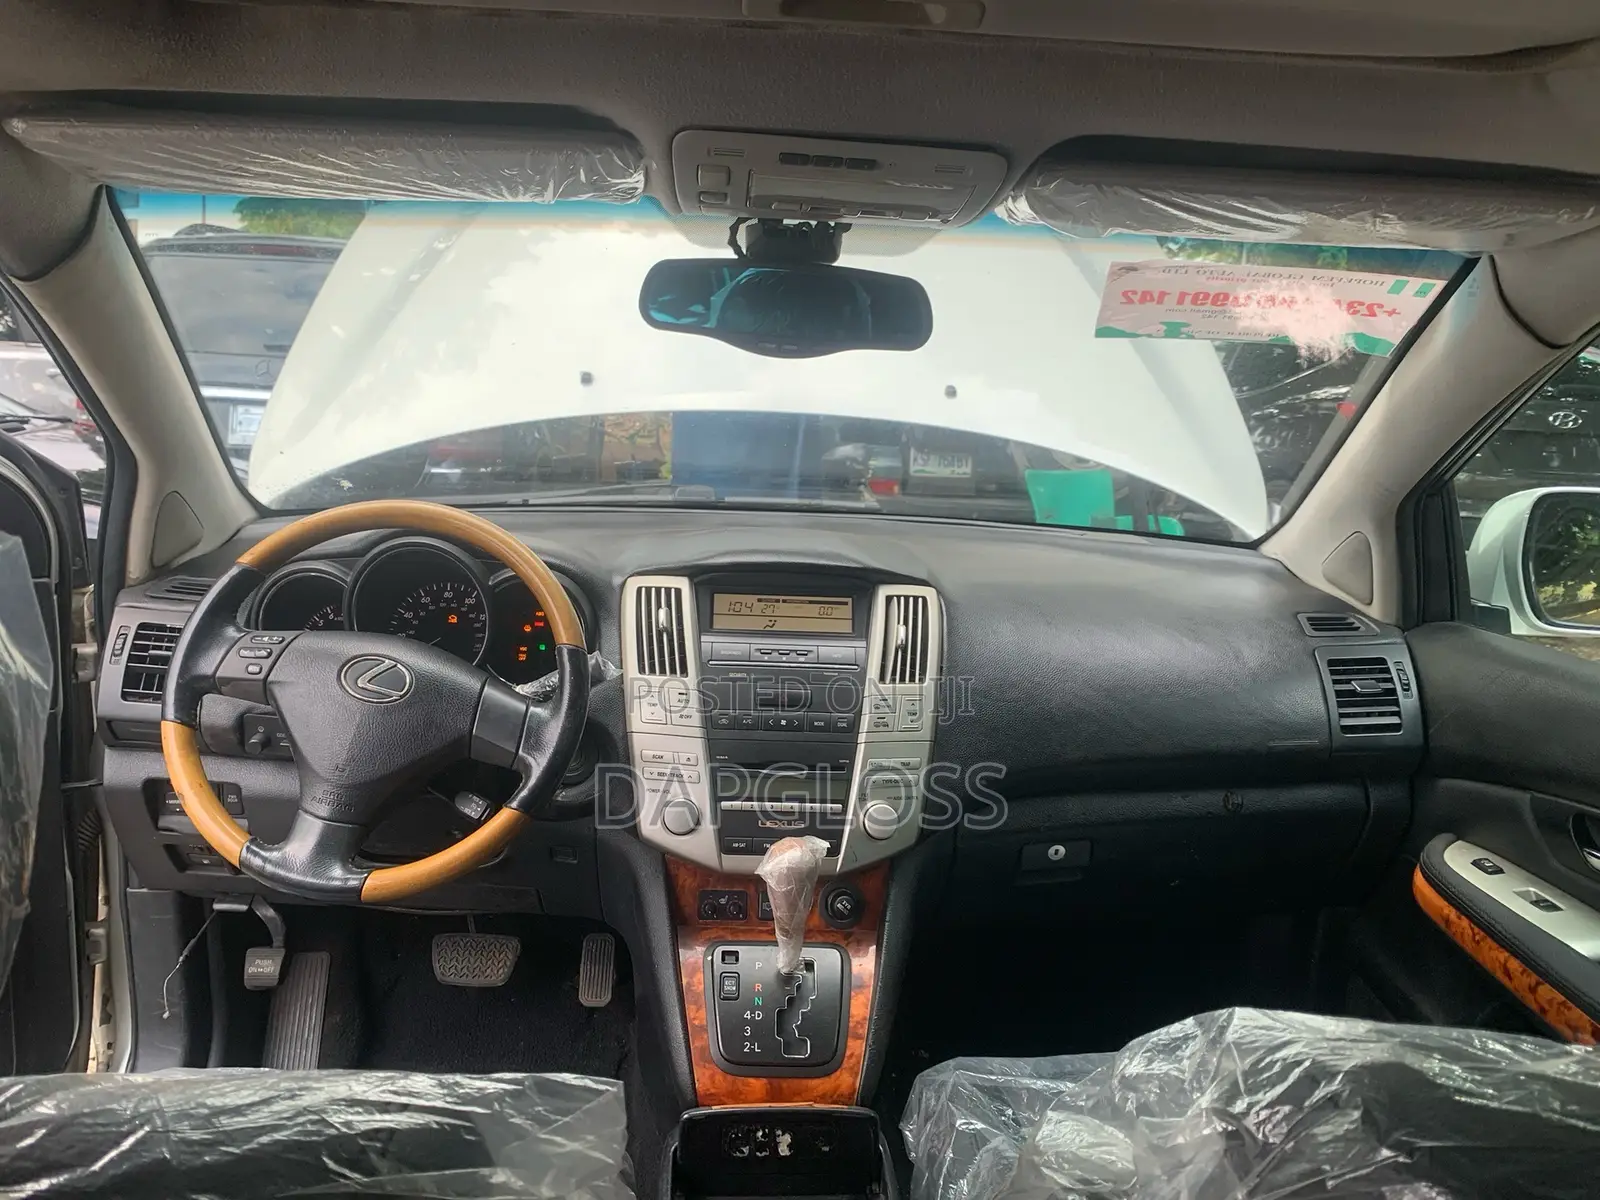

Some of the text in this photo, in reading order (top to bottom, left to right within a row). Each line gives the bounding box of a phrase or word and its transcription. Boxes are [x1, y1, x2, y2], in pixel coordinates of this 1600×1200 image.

[761, 603, 776, 613] 27
[328, 612, 334, 620] 6
[318, 619, 324, 627] 5
[758, 819, 805, 828] LEXUS
[755, 961, 763, 970] P
[754, 983, 763, 992] R
[754, 997, 763, 1006] N
[743, 1010, 763, 1020] 4-D
[743, 1025, 751, 1036] 3
[743, 1041, 762, 1052] 2-L
